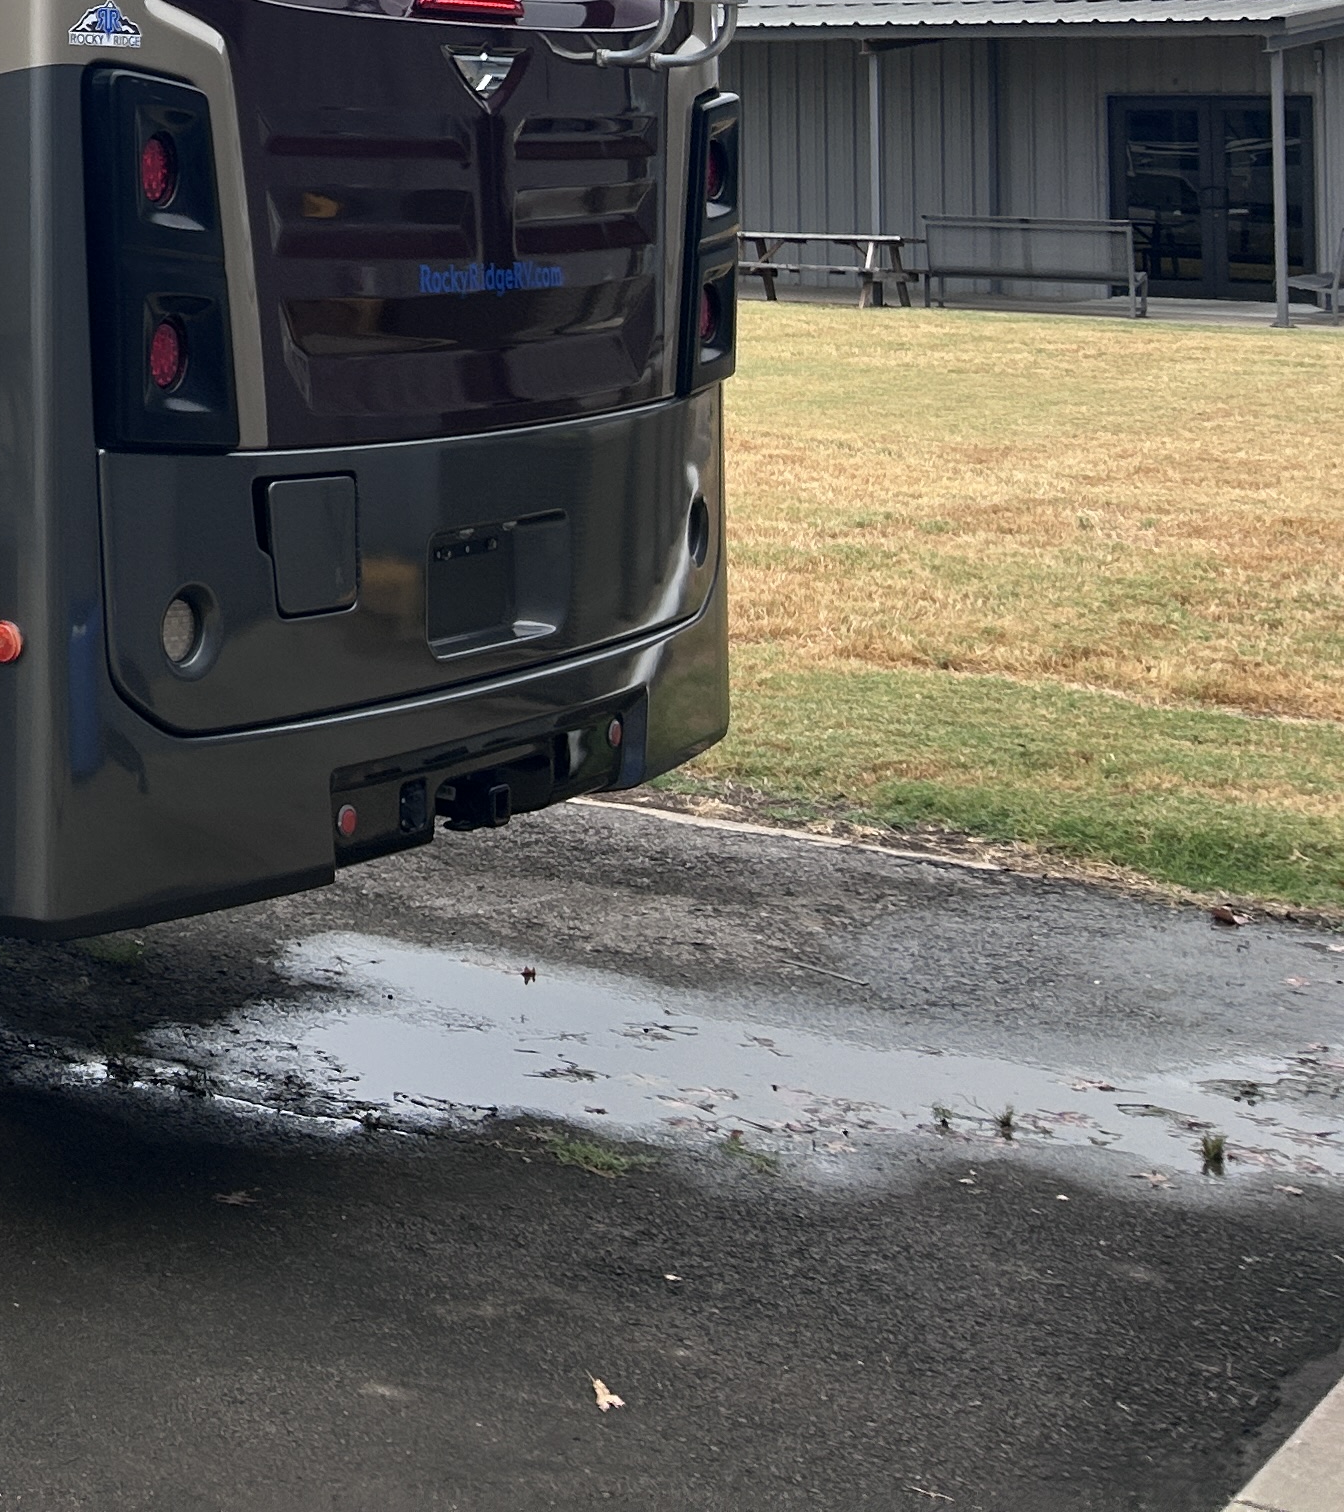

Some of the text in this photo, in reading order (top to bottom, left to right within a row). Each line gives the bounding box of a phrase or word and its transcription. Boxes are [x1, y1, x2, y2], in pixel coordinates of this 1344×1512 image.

[70, 33, 141, 47] ROCKY RIDGE
[419, 260, 564, 297] RockyRidgeRV.com
